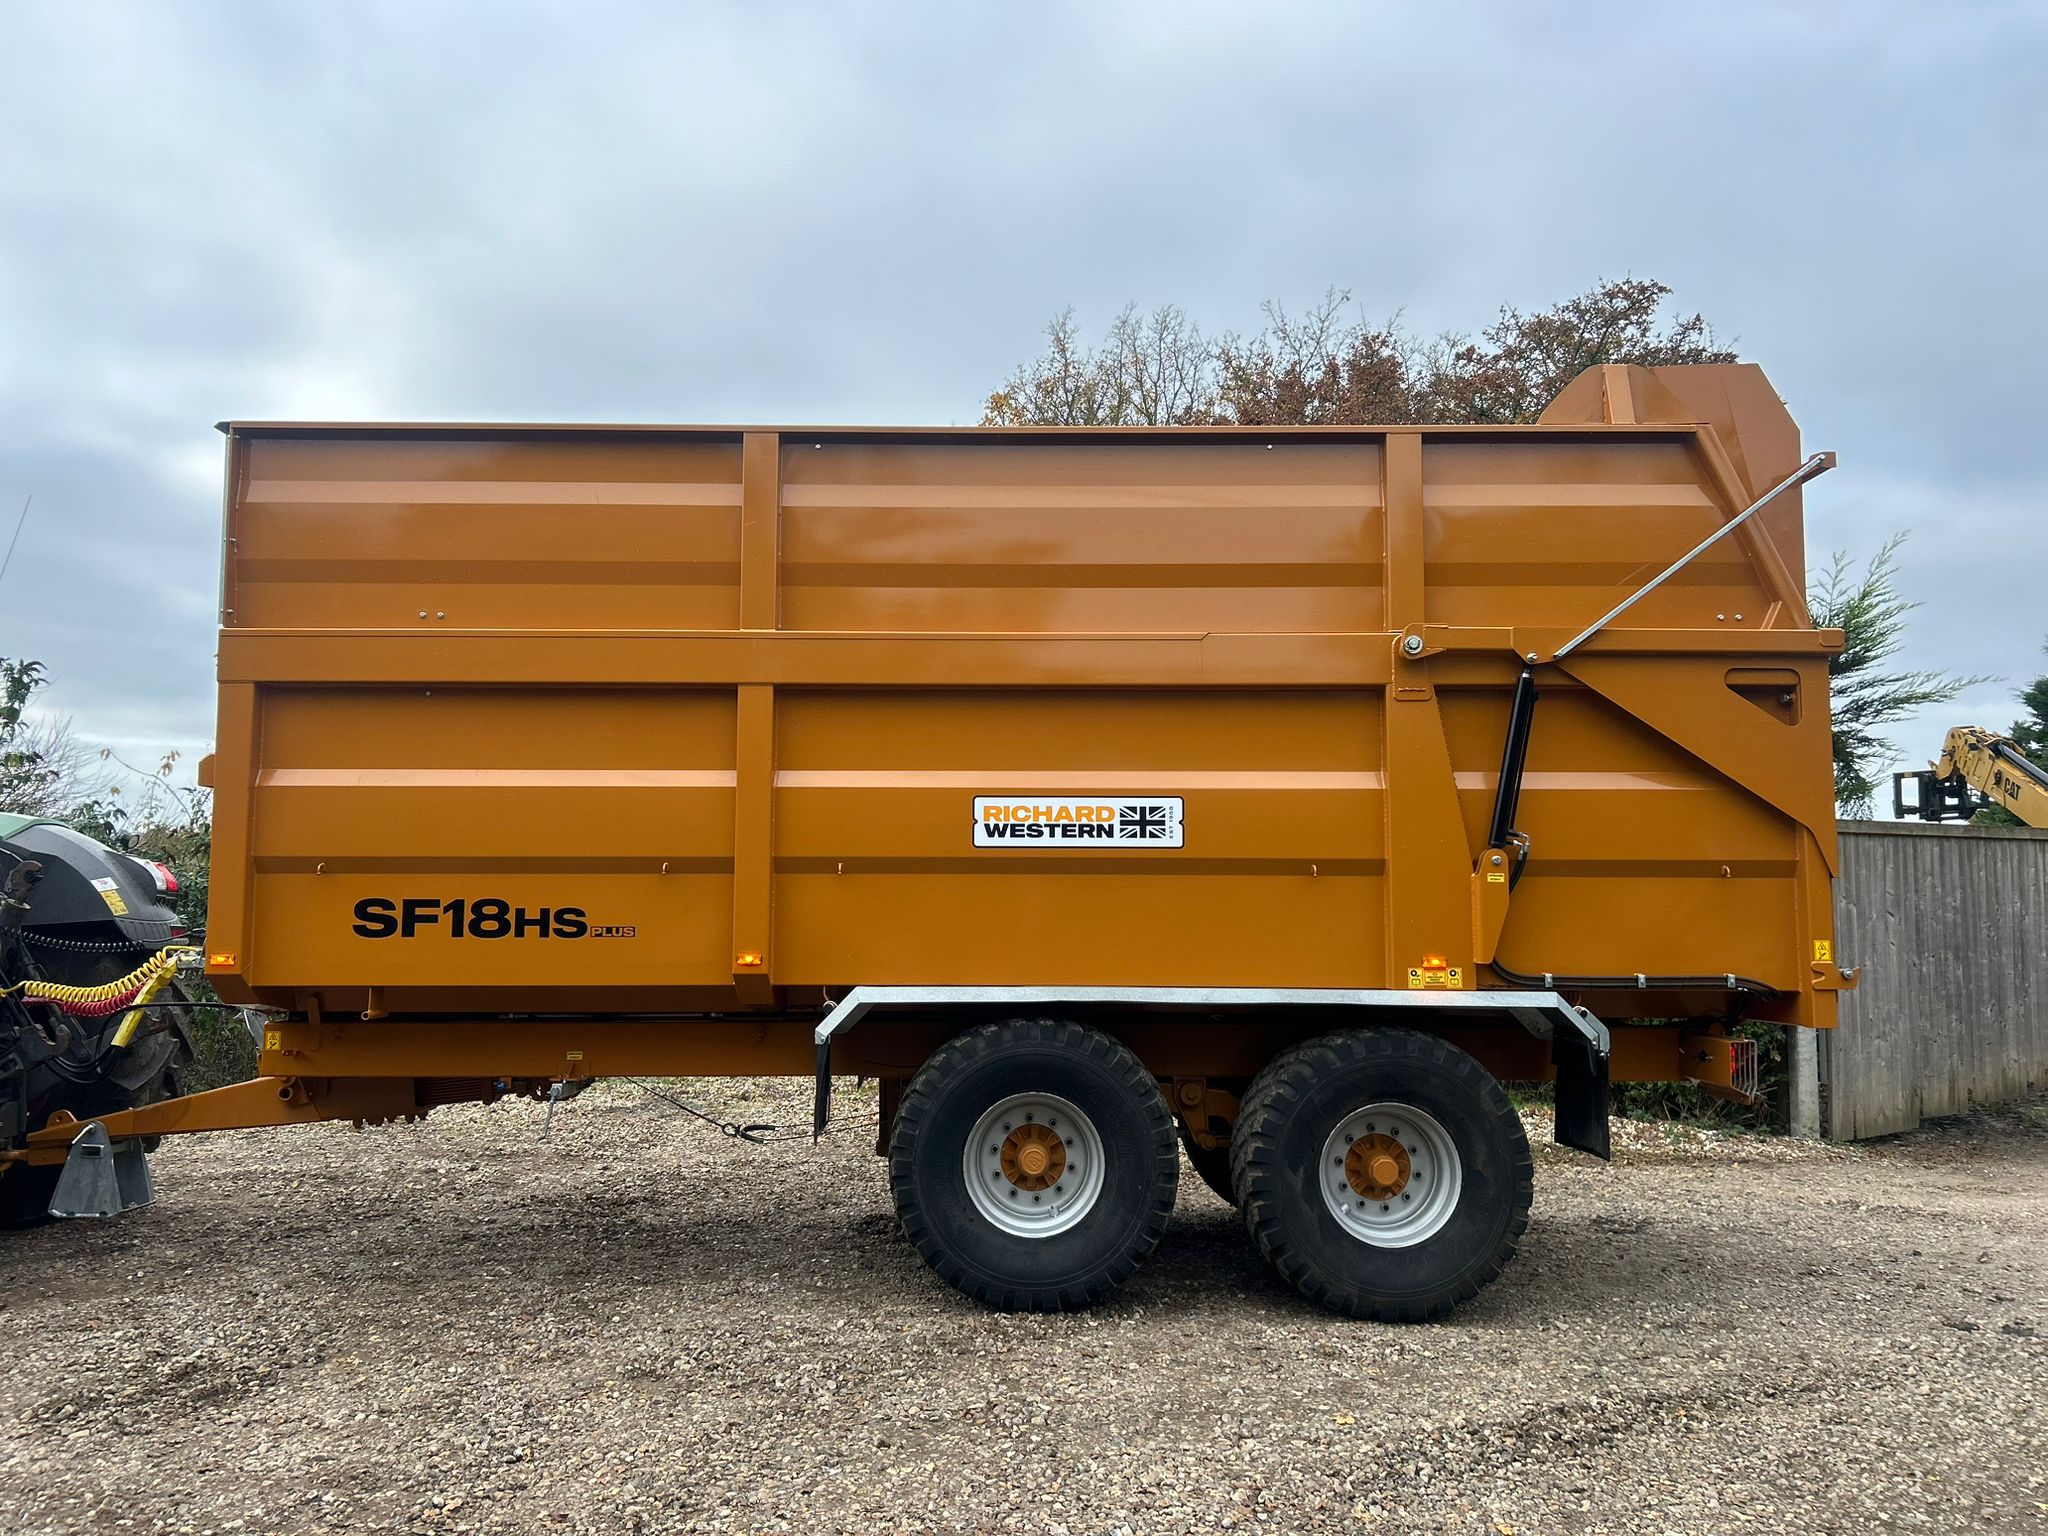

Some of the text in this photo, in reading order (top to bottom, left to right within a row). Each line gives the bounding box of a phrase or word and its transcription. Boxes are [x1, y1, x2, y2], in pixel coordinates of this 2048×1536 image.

[2004, 777, 2021, 801] CAT
[983, 805, 1116, 822] RICHARD
[984, 823, 1115, 839] WESTERN
[351, 897, 635, 939] SF18HS PLUS
